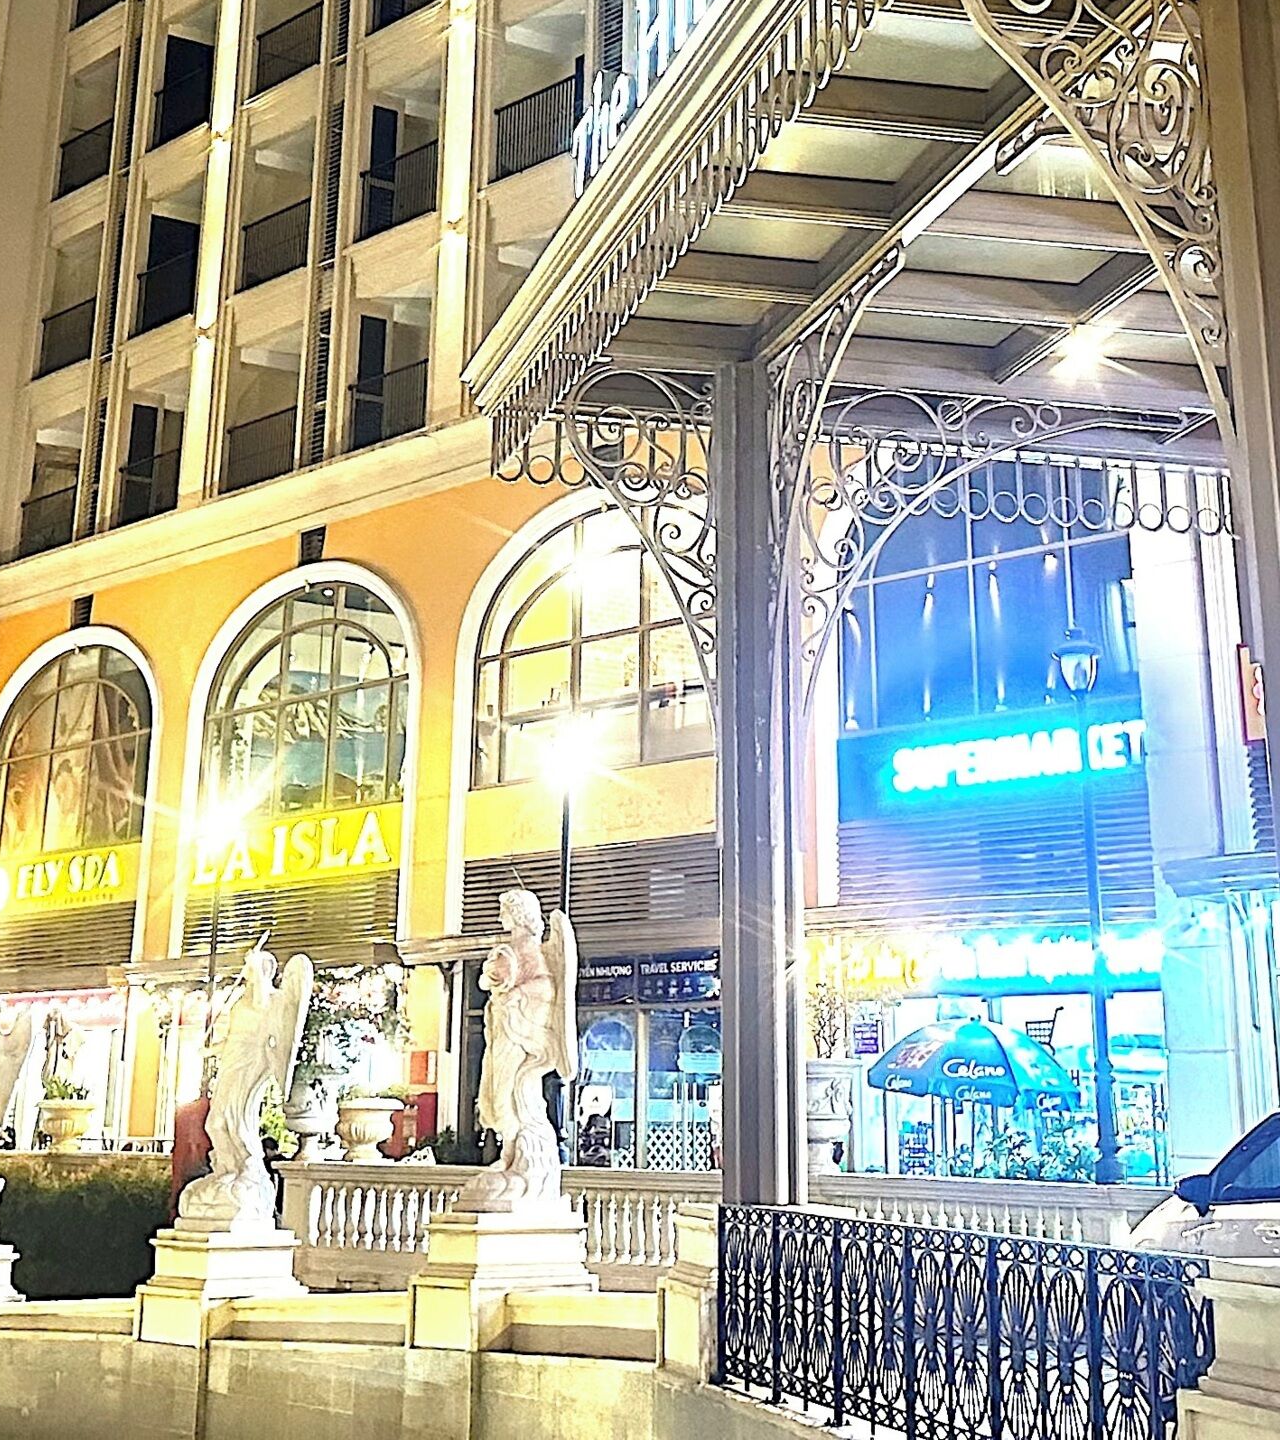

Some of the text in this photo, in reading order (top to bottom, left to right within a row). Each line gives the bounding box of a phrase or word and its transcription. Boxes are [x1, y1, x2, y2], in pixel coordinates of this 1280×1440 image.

[192, 811, 393, 886] LA ISLA
[639, 963, 669, 975] TRAVEL
[942, 1058, 1007, 1080] Celano
